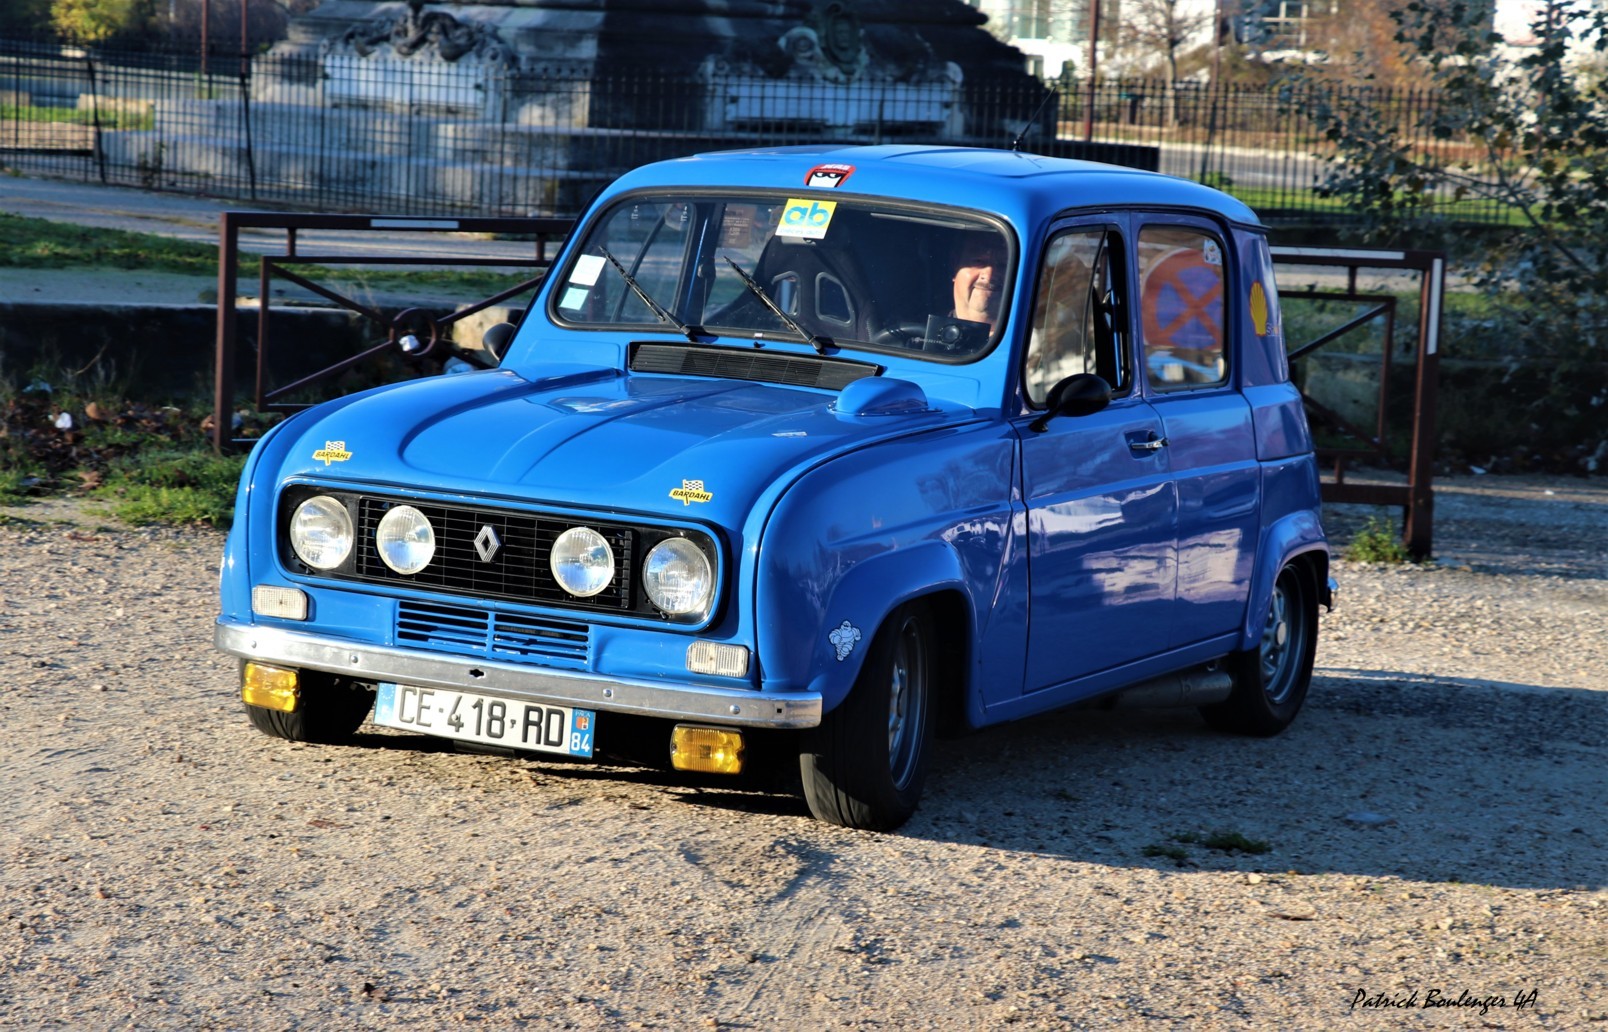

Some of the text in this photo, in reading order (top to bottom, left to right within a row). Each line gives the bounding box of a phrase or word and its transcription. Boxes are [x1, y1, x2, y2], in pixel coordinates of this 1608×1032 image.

[784, 202, 830, 227] ab
[315, 451, 350, 460] BARDAHL
[672, 490, 711, 501] BARDAHL
[570, 732, 590, 752] 84
